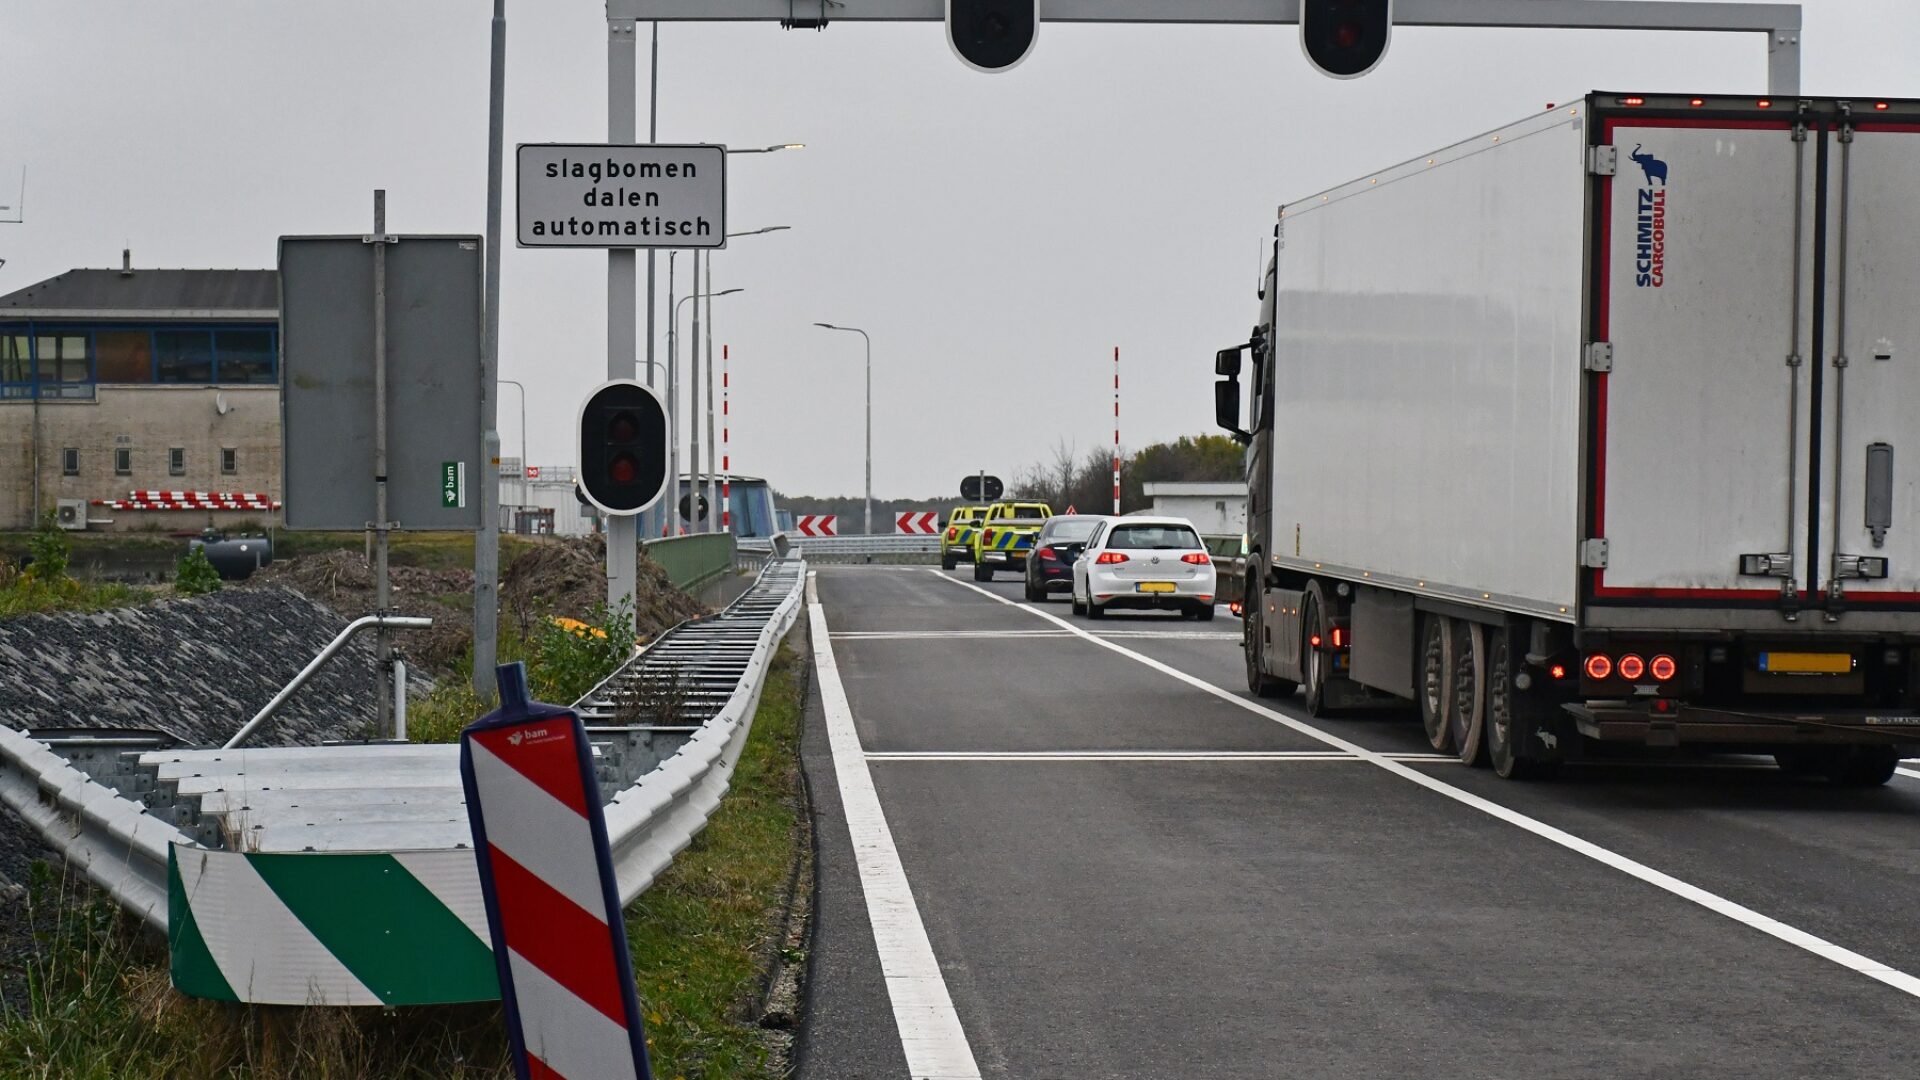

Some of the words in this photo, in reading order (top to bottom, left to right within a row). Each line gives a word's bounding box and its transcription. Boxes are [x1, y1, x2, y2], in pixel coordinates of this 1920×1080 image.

[546, 158, 697, 184] slagbomen
[583, 186, 659, 207] dalen
[532, 216, 710, 236] automatisch
[1636, 188, 1653, 288] SCHMITZ
[1652, 189, 1666, 288] CARGOBULL
[445, 466, 455, 488] bam
[524, 729, 548, 739] bam
